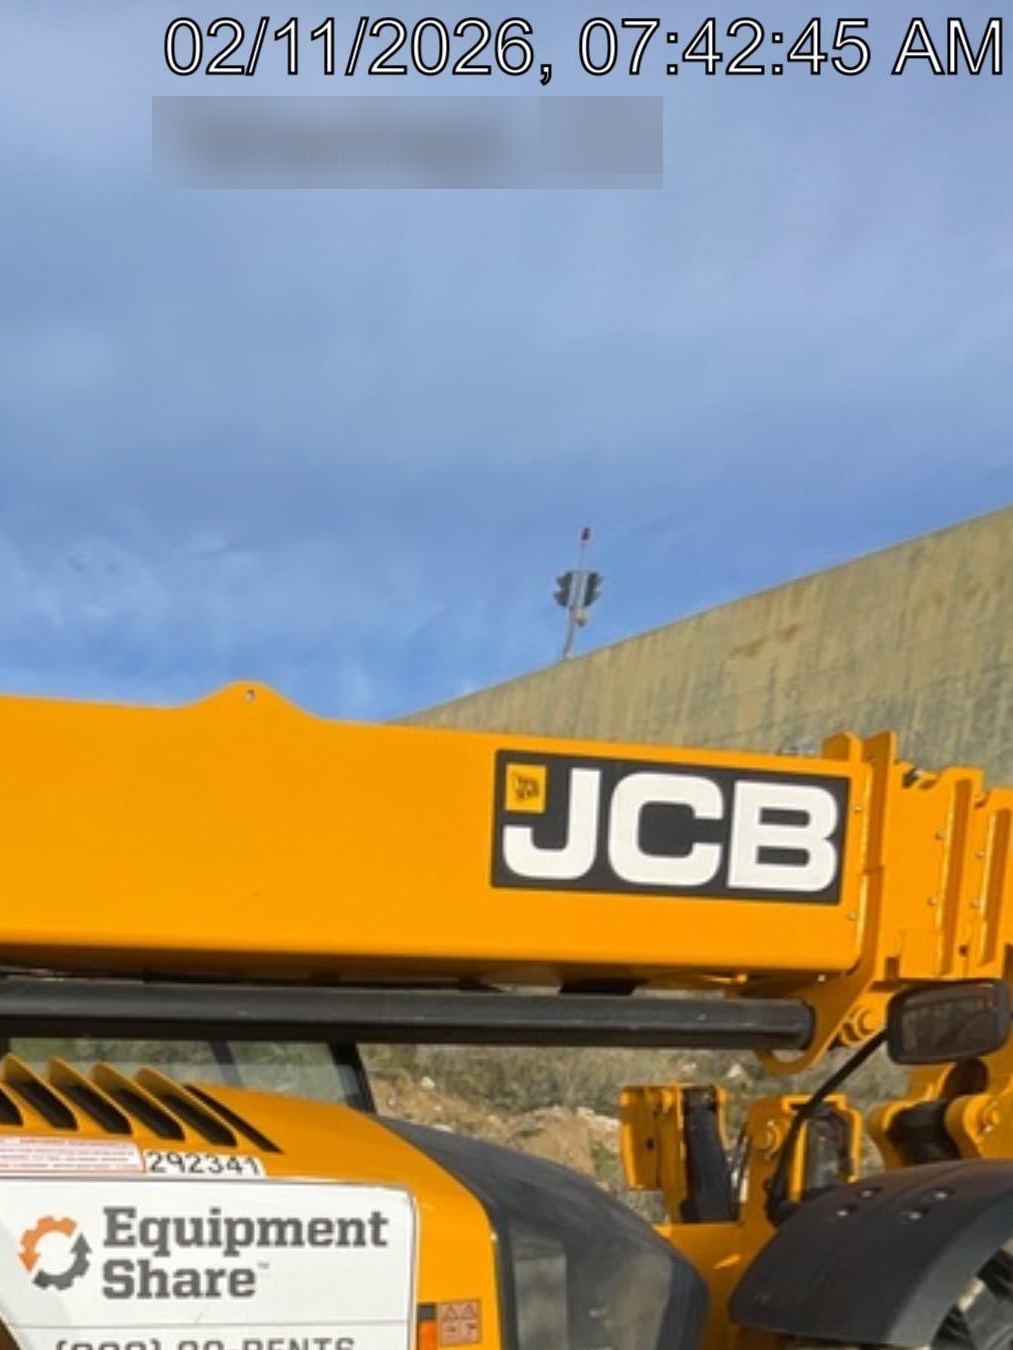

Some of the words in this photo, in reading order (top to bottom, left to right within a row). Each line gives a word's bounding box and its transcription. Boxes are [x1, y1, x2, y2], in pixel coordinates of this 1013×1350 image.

[502, 767, 839, 893] JCB
[103, 1206, 389, 1257] Equipment
[102, 1258, 256, 1299] Share
